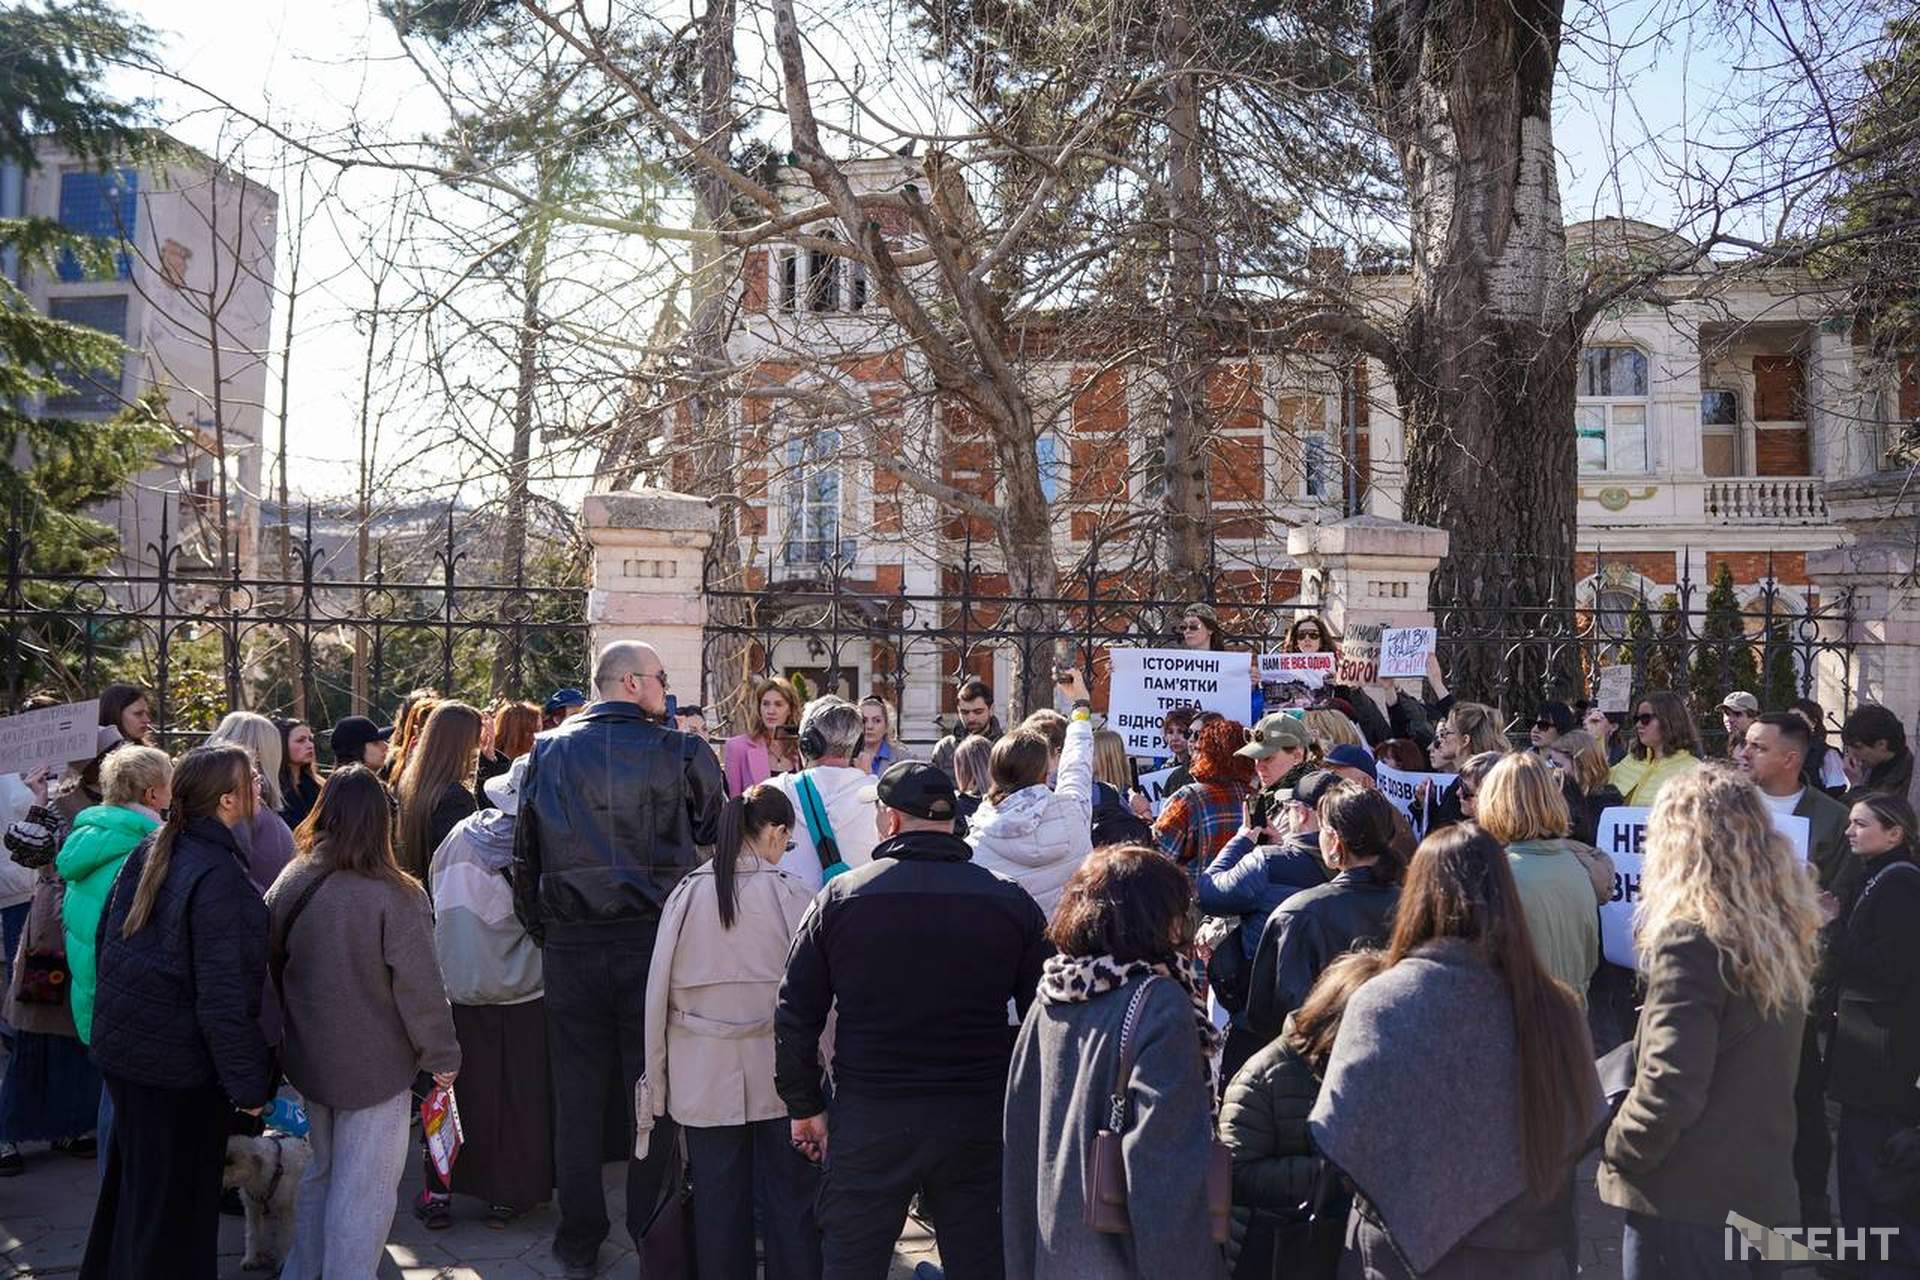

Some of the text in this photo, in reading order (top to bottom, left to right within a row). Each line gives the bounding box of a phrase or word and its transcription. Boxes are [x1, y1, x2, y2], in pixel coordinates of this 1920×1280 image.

[1143, 657, 1219, 673] ІСТОРИЧНІ
[1263, 657, 1279, 670] НАМ
[1281, 657, 1290, 670] НЕ
[1307, 656, 1331, 669] ОДНО
[1144, 677, 1218, 693] ПАМ'ЯТКИ
[1157, 697, 1202, 711] ТРЕБА
[1118, 714, 1164, 730] ВІДНО
[1128, 735, 1169, 749] НЕ РУ
[1613, 823, 1648, 853] НЕ
